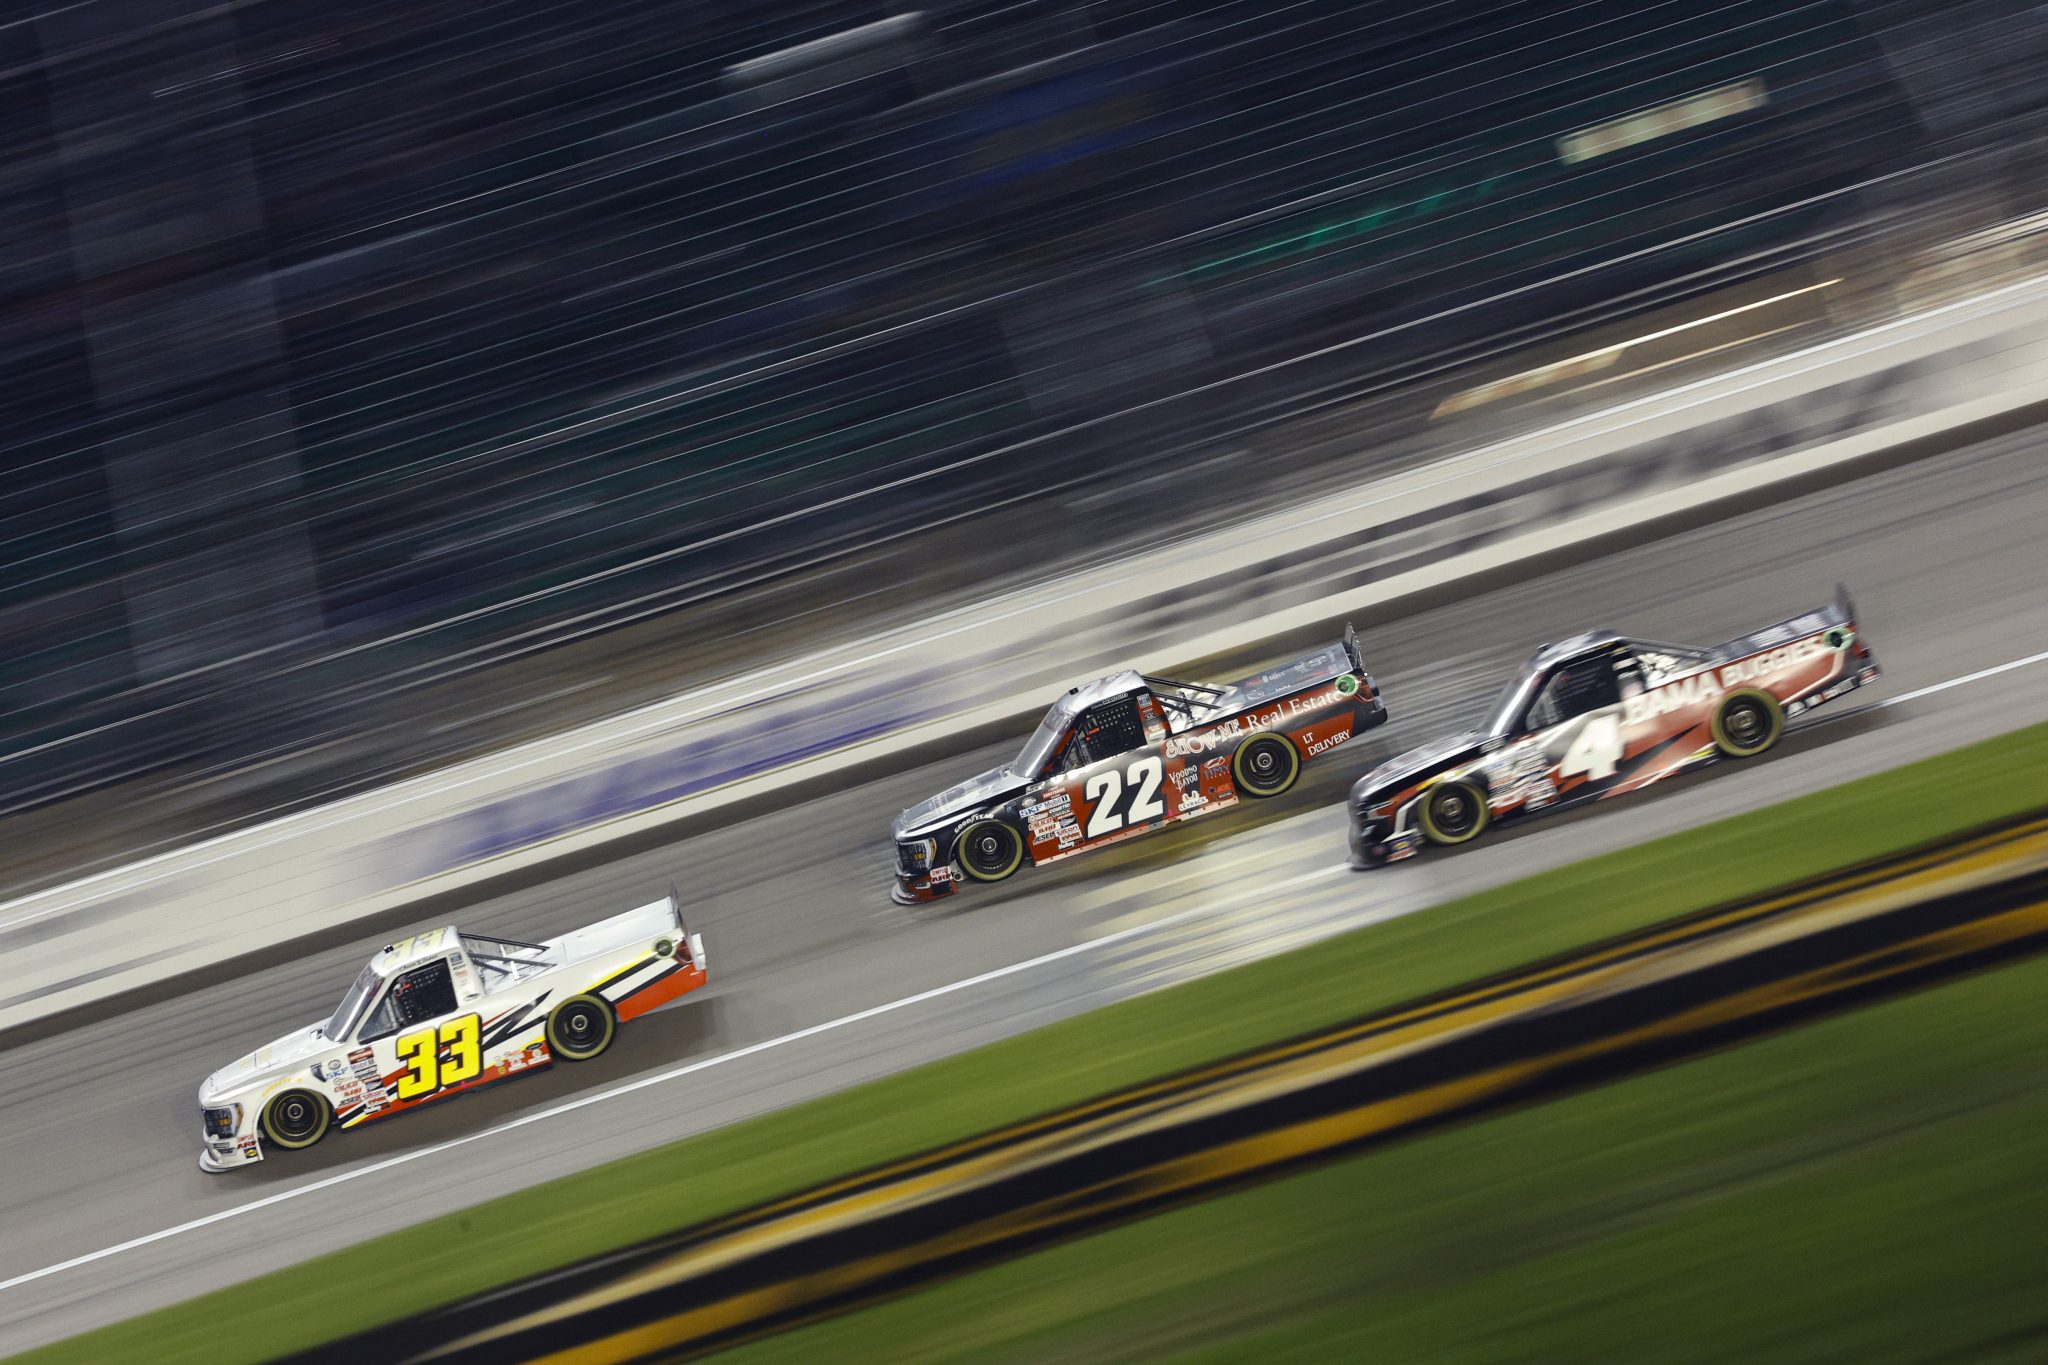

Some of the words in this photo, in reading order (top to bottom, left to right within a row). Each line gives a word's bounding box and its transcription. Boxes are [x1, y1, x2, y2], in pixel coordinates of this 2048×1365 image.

[1622, 671, 1724, 727] BAMA
[1166, 718, 1243, 759] SHOW-ME
[1244, 704, 1286, 730] Real
[1289, 690, 1343, 716] Estate
[1302, 732, 1314, 745] LT
[1307, 729, 1351, 757] DELIVERY
[1560, 713, 1626, 782] 4
[1168, 764, 1198, 785] VOODOO
[1175, 772, 1199, 792] BAYOU
[1044, 798, 1061, 808] Mobil
[1085, 755, 1164, 839] 22
[1179, 797, 1206, 811] LEVRACK
[1020, 803, 1043, 817] SKF
[954, 813, 994, 834] GOODYEAR
[396, 1012, 482, 1101] 33
[325, 1066, 349, 1080] SKF
